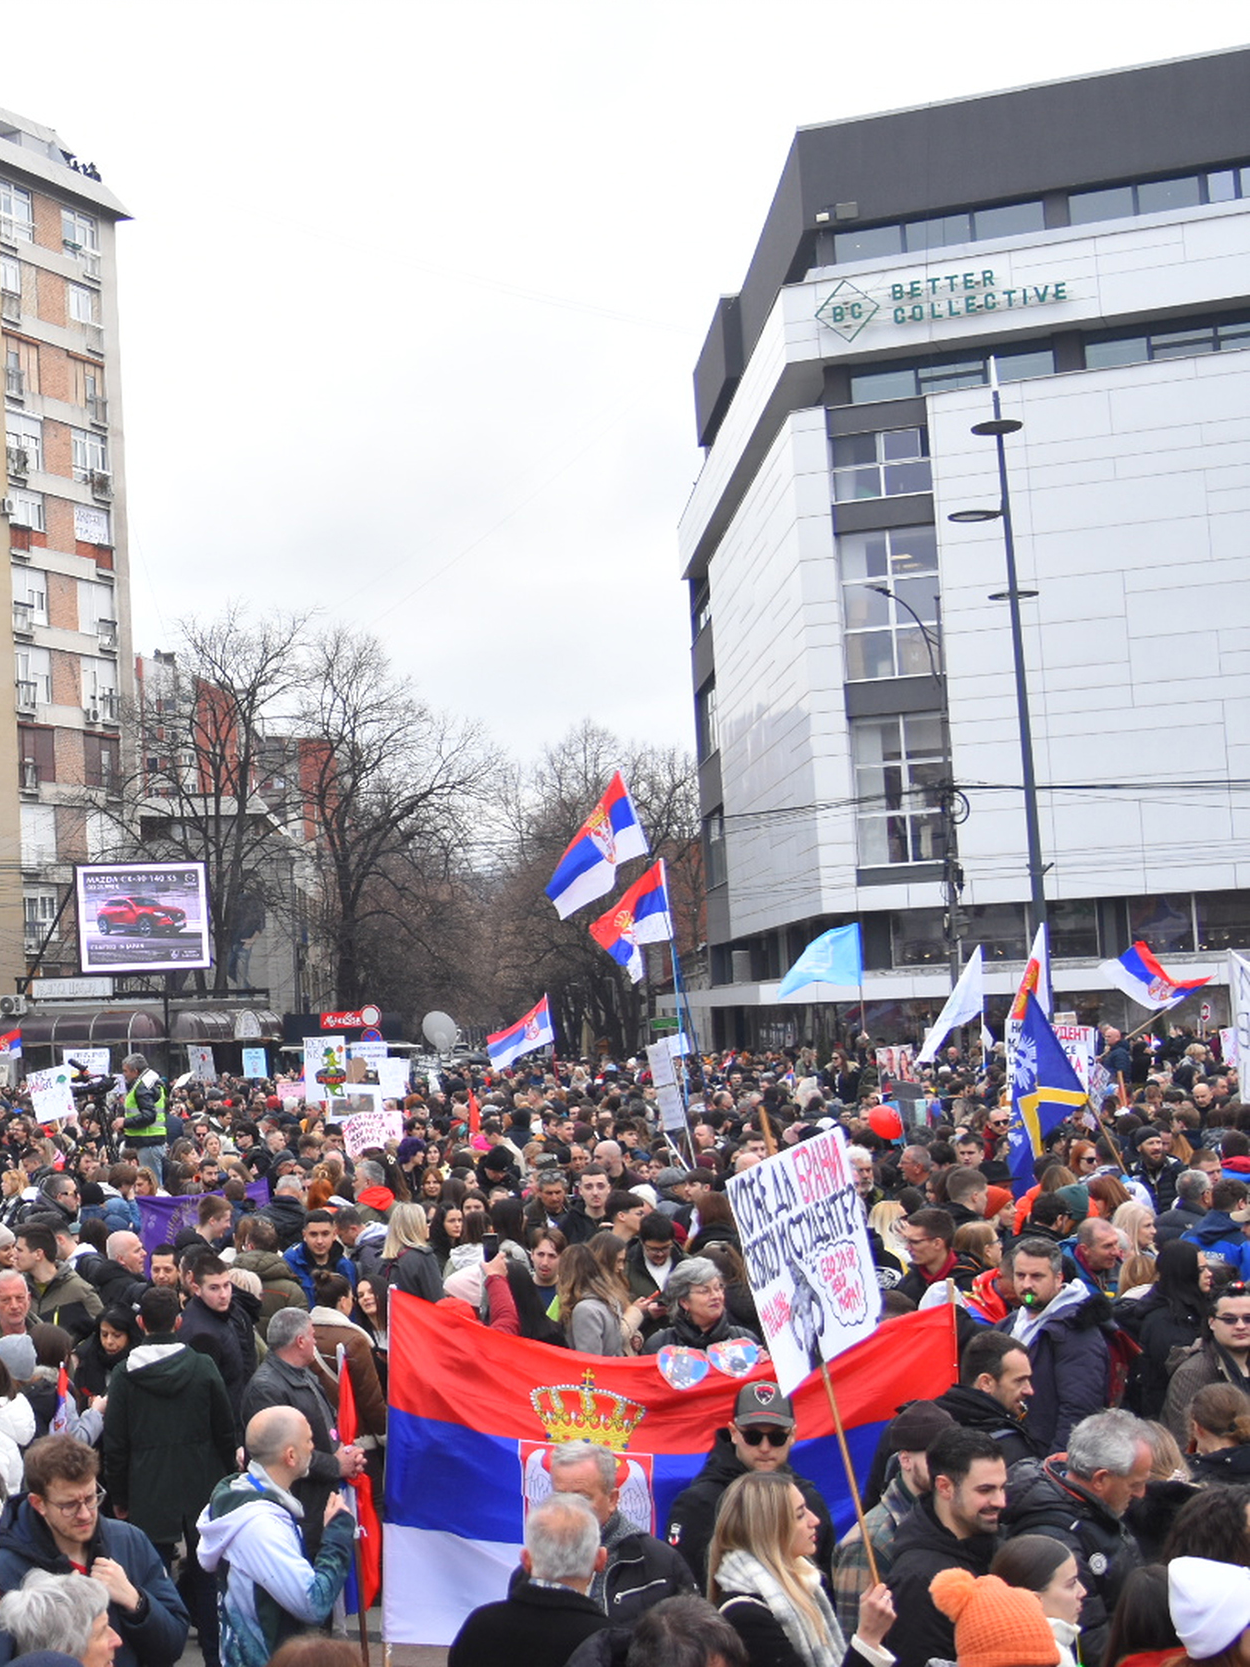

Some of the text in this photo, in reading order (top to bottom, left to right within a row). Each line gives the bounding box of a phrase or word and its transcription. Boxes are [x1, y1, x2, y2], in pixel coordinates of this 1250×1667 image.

[891, 269, 995, 300] BETTER
[832, 303, 863, 322] BC
[893, 282, 1067, 324] COLLECTIVE
[87, 876, 118, 884] MAZDA
[771, 1161, 797, 1218] ДА
[791, 1134, 846, 1204] БРАНИ
